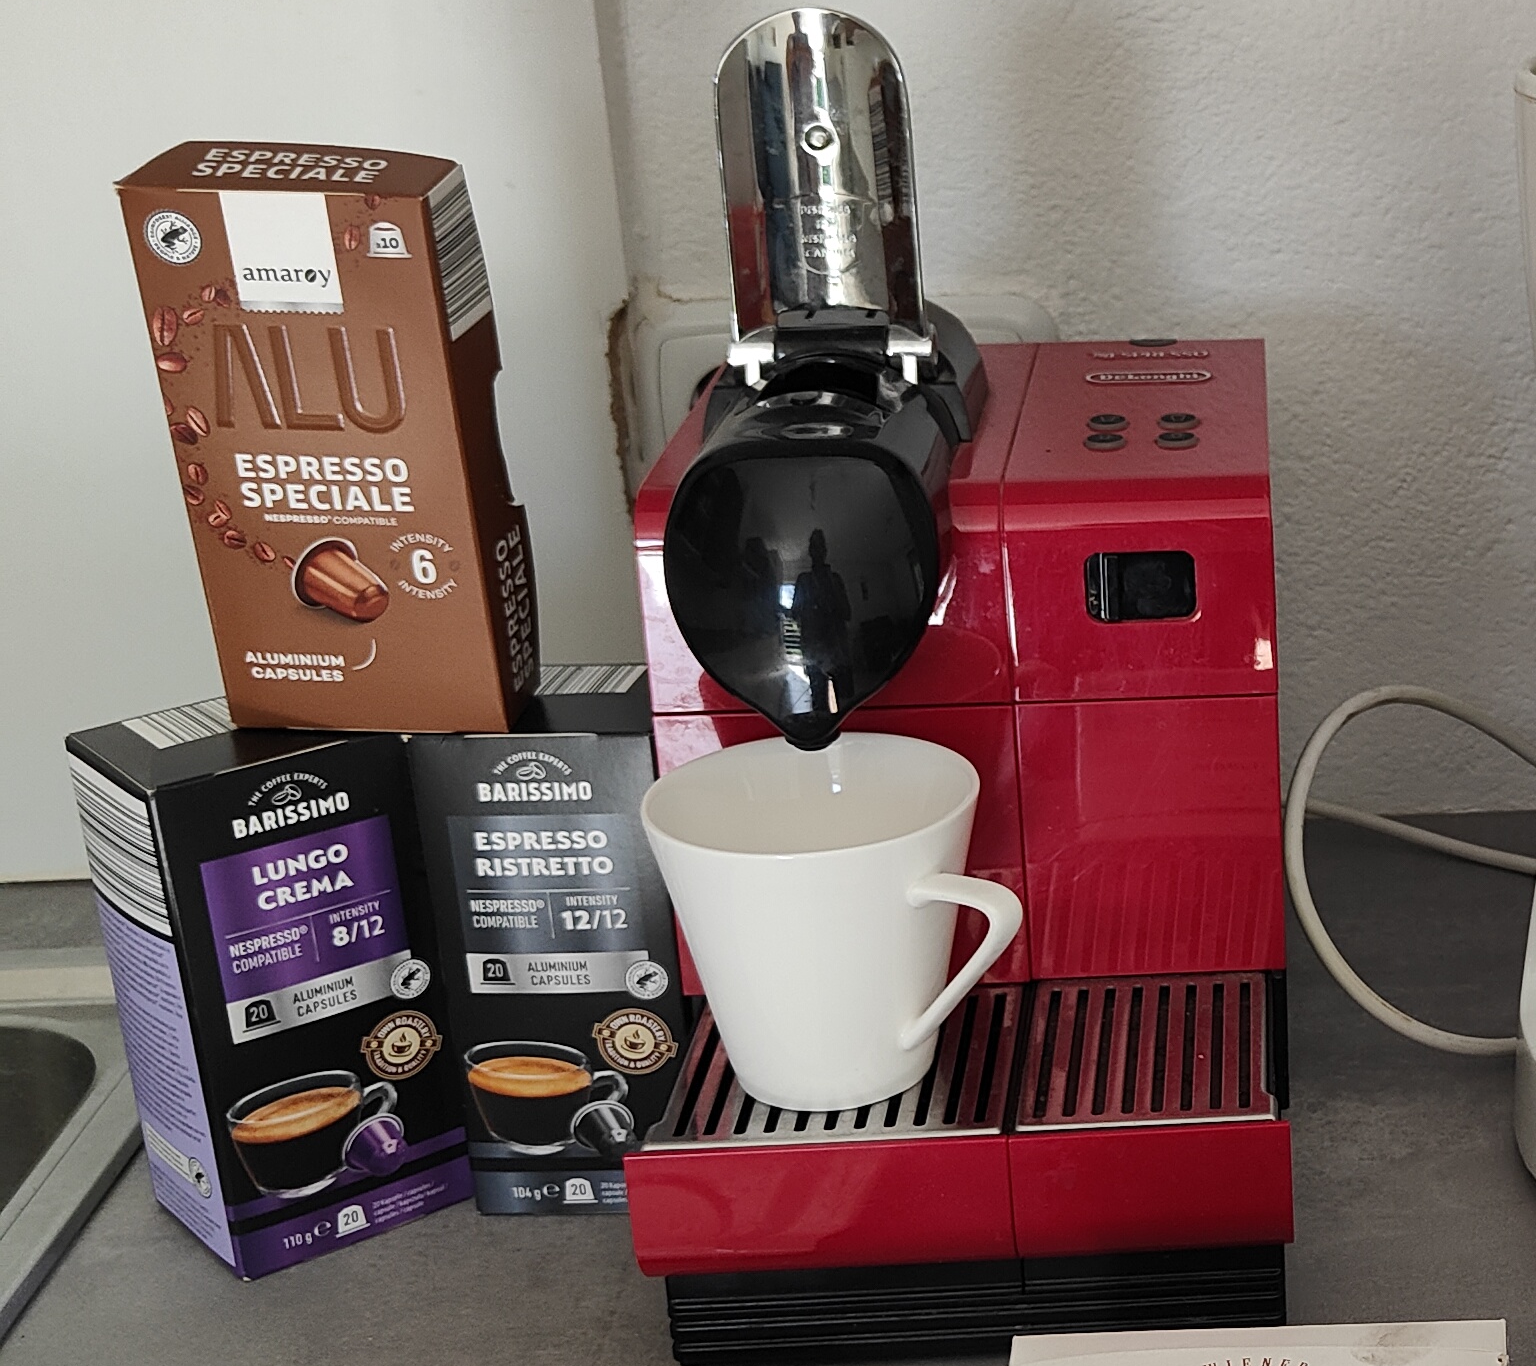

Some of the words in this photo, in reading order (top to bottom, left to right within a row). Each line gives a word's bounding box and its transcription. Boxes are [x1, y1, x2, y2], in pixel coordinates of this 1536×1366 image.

[204, 148, 388, 171] ESPRESSO
[191, 162, 379, 183] SPECIALE
[242, 267, 331, 288] amaroy
[234, 453, 409, 483] ESPRESSO
[240, 481, 415, 512] SPECIALE
[333, 515, 398, 526] COMPATIBLE
[390, 533, 454, 553] INTENSITY
[411, 548, 437, 584] 6
[398, 578, 458, 599] INTENSITY
[508, 523, 534, 679] SPECIALE
[496, 539, 525, 692] ESPRESSO
[245, 650, 345, 667] ALUMINIUM
[251, 666, 344, 682] CAPSULES
[493, 761, 507, 776] THE
[506, 751, 537, 765] COFFEE
[538, 752, 573, 776] EXPERTS
[248, 791, 264, 807] THE
[261, 773, 291, 792] COFFEE
[294, 772, 328, 790] EXPERTS
[477, 781, 593, 802] BARISSIMO
[232, 791, 350, 839] BARISSIMO
[474, 830, 607, 851] ESPRESSO
[252, 843, 349, 886] LUNGO
[475, 856, 614, 877] RISTRETTO
[257, 870, 354, 911] CREMA
[565, 895, 618, 907] INTENSITY
[329, 900, 380, 924] INTENSITY
[473, 915, 538, 929] COMPATIBLE
[561, 909, 628, 930] 12/12
[332, 915, 385, 947] 8/12
[233, 944, 303, 974] COMPATIBLE
[527, 960, 588, 973] ALUMINIUM
[486, 962, 503, 978] 20
[531, 974, 591, 986] CAPSULES
[293, 976, 354, 1004] ALUMINIUM
[250, 1004, 269, 1022] 20
[297, 989, 358, 1017] CAPSULES
[378, 1021, 395, 1039] OWN
[395, 1016, 431, 1039] ROASTERY
[610, 1015, 628, 1031] OWN
[629, 1013, 666, 1042] ROASTERY
[512, 1186, 532, 1198] 104
[534, 1189, 542, 1201] g
[570, 1183, 587, 1196] 20
[343, 1210, 359, 1226] 20
[283, 1233, 303, 1250] 110
[305, 1232, 312, 1245] g
